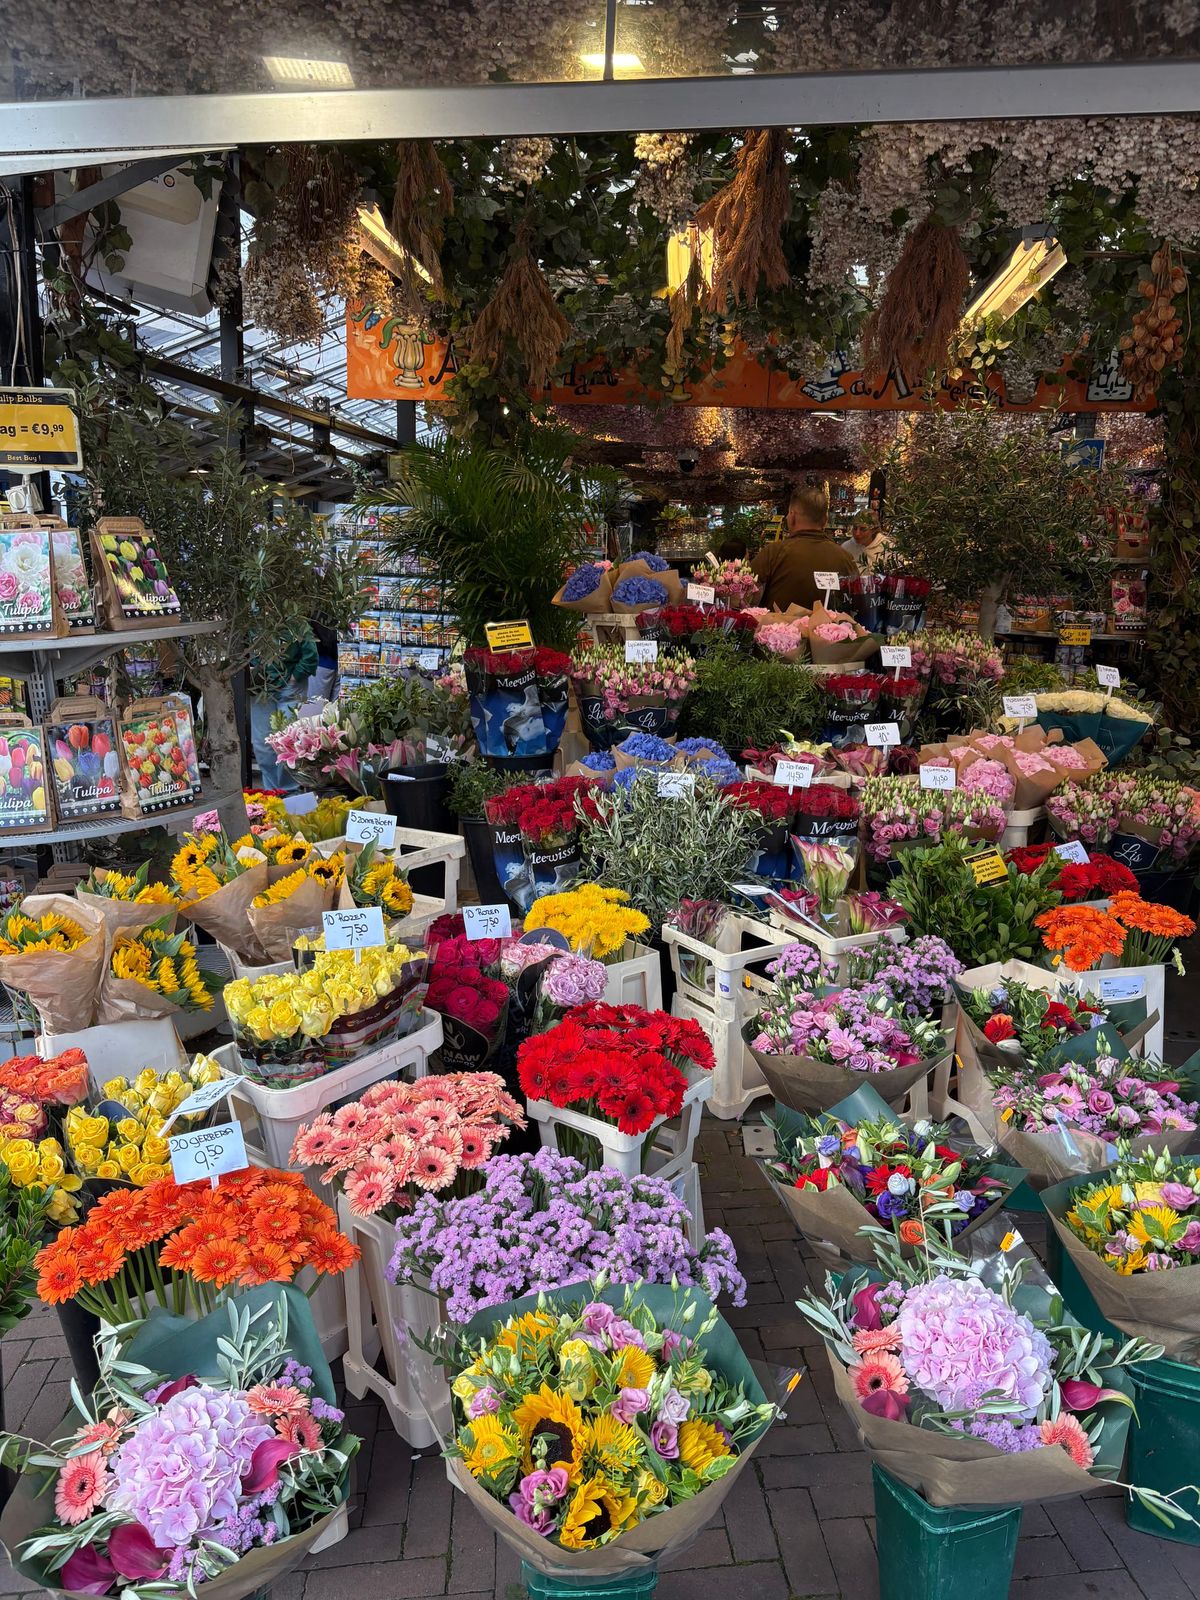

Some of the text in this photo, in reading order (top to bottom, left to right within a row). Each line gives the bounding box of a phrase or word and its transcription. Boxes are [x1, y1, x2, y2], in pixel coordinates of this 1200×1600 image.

[0, 394, 43, 405] ulip Bulbs
[0, 424, 17, 437] ag
[32, 423, 64, 437] €9,99
[132, 593, 167, 604] Tulipa
[3, 603, 41, 619] Tulipa
[497, 669, 536, 688] Meewiss
[638, 711, 658, 731] Lis
[72, 785, 112, 799] Tulipa
[149, 782, 182, 796] Tulipa
[0, 798, 33, 811] ulipa
[495, 831, 522, 843] Meew
[1113, 843, 1143, 867] Lis
[170, 1138, 189, 1152] 20
